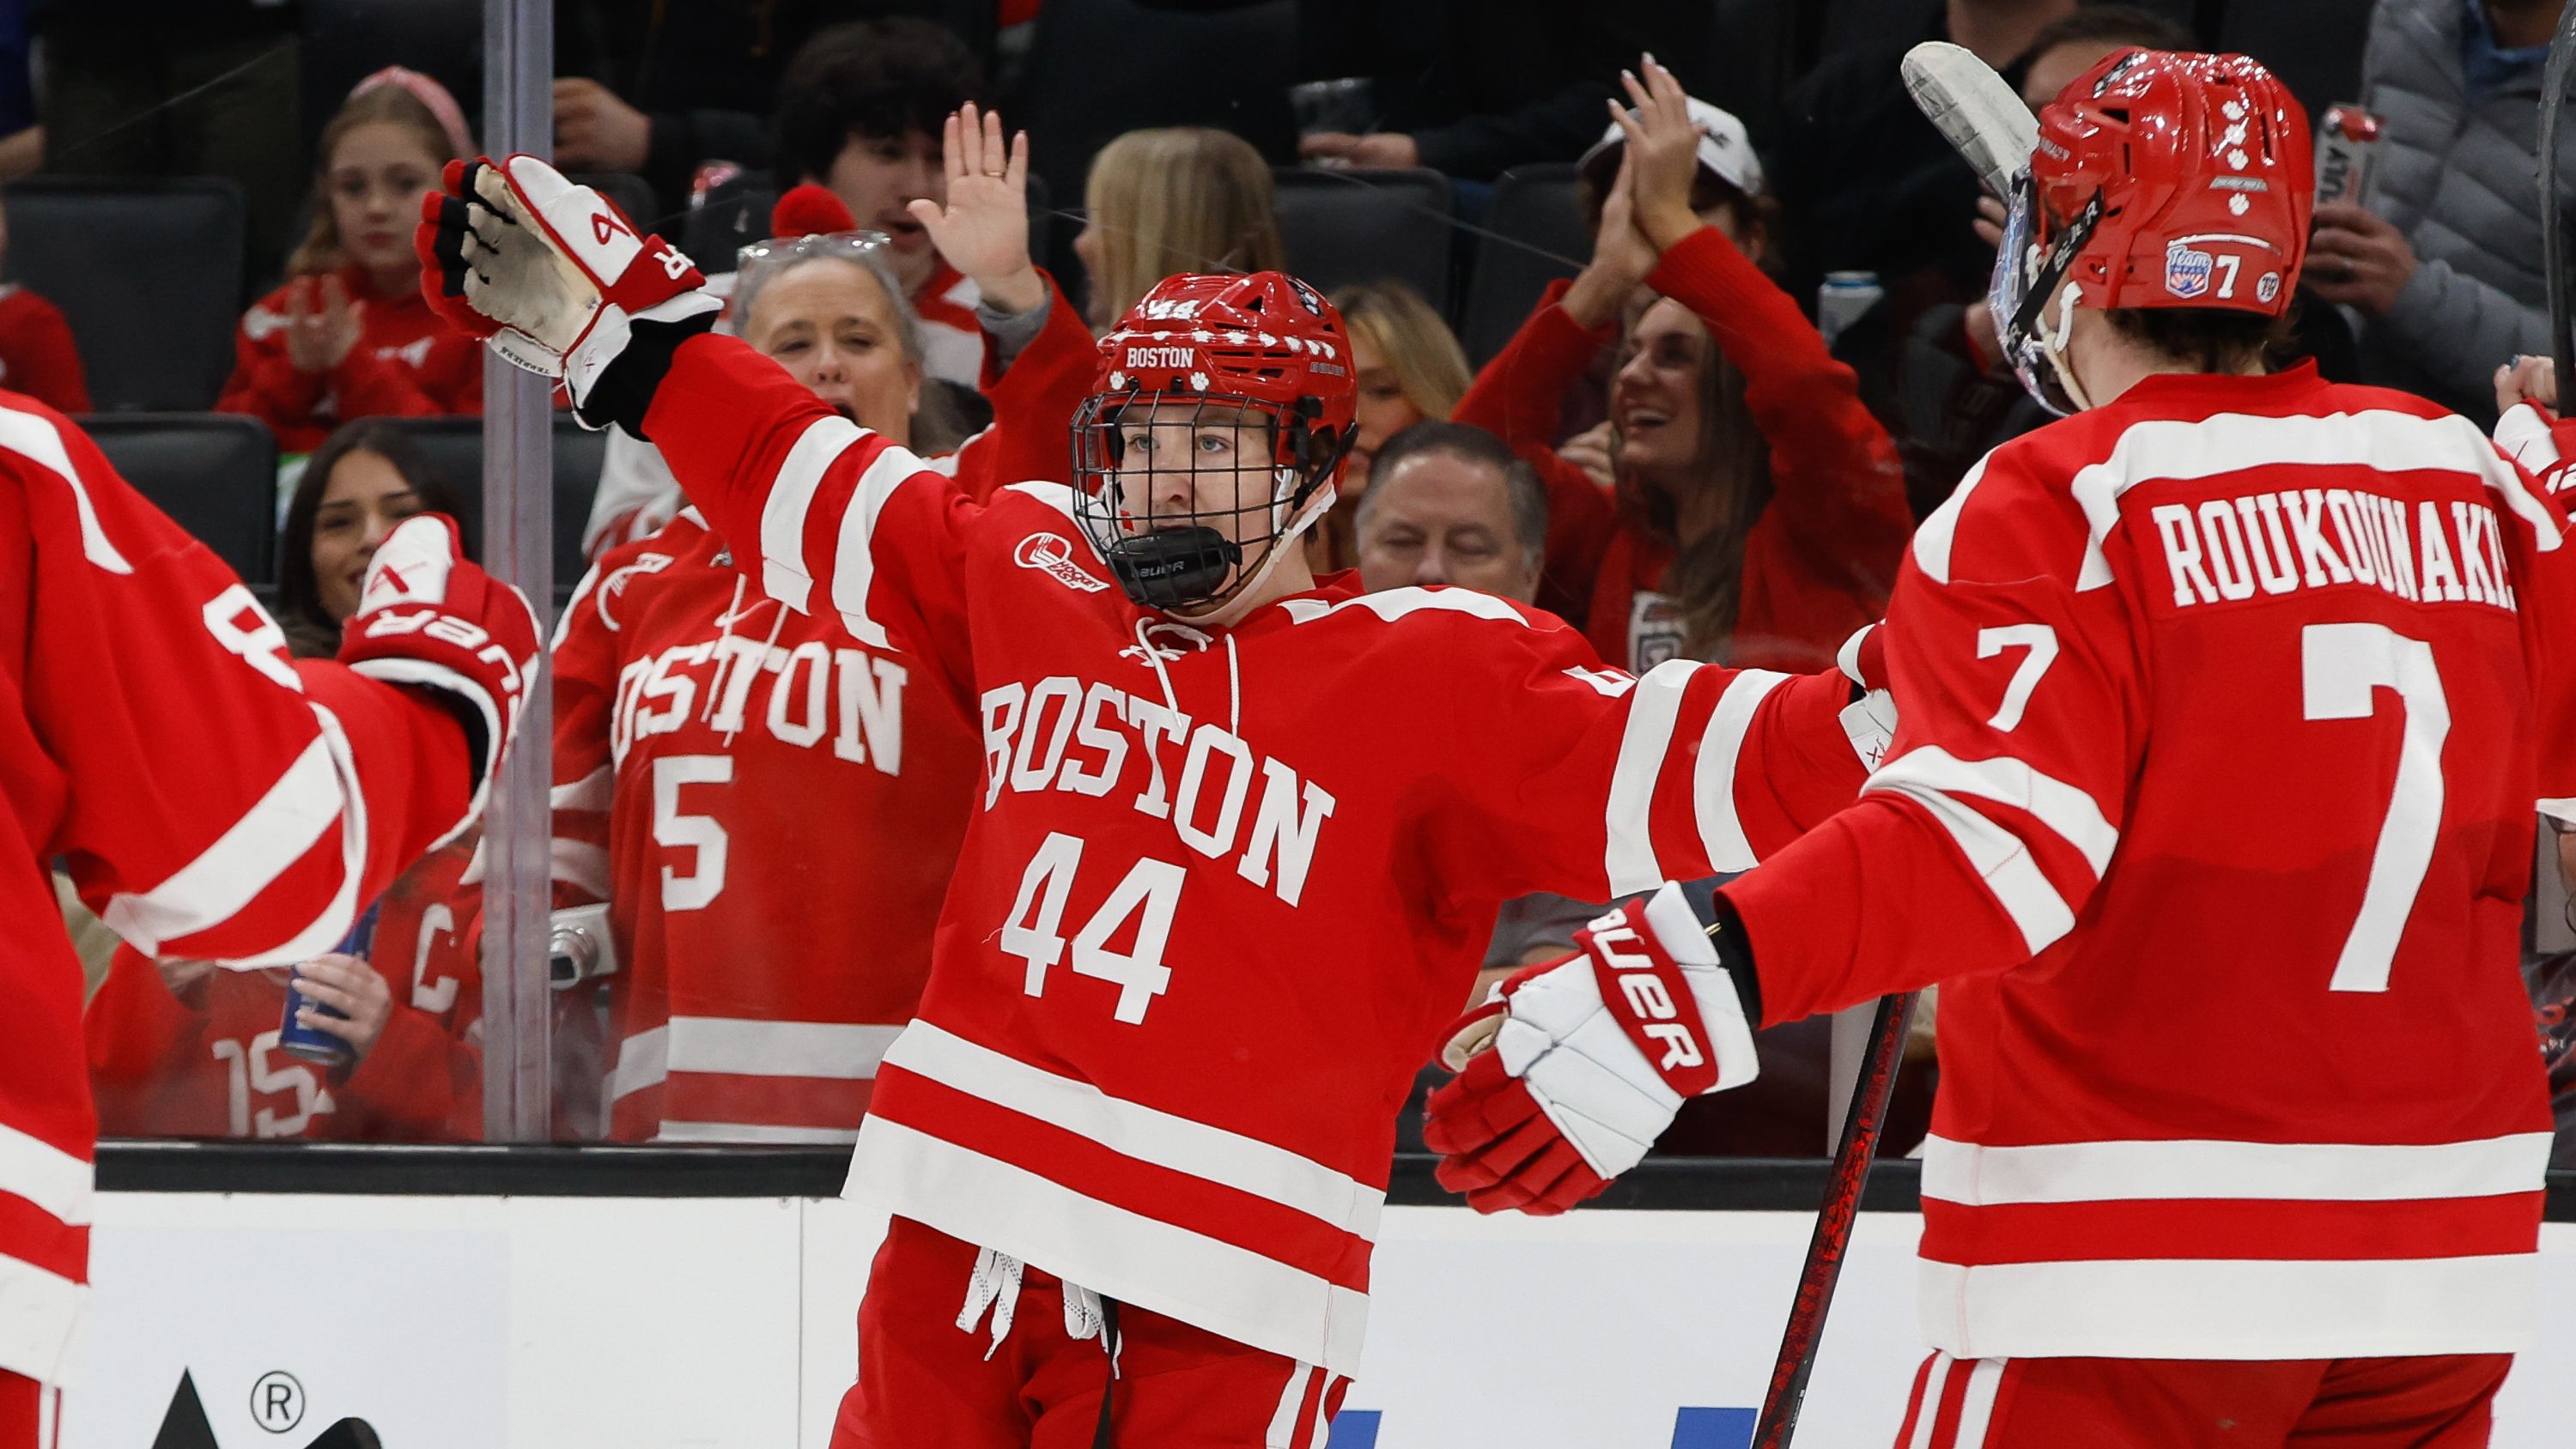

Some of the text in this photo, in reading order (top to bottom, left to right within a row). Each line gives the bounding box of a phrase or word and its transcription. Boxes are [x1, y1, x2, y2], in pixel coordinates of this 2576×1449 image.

[2170, 247, 2210, 268] Team
[2215, 254, 2242, 299] 7
[1126, 347, 1194, 368] BOSTON
[1056, 561, 1102, 589] HOCKEY
[1132, 561, 1185, 578] AUER
[611, 635, 909, 778] OSTON
[1977, 623, 2060, 732] 7
[653, 754, 734, 912] 5
[981, 676, 1337, 908] BOSTON
[2301, 621, 2452, 992] 7
[1000, 831, 1188, 1026] 44
[1587, 907, 1704, 1071] AUER
